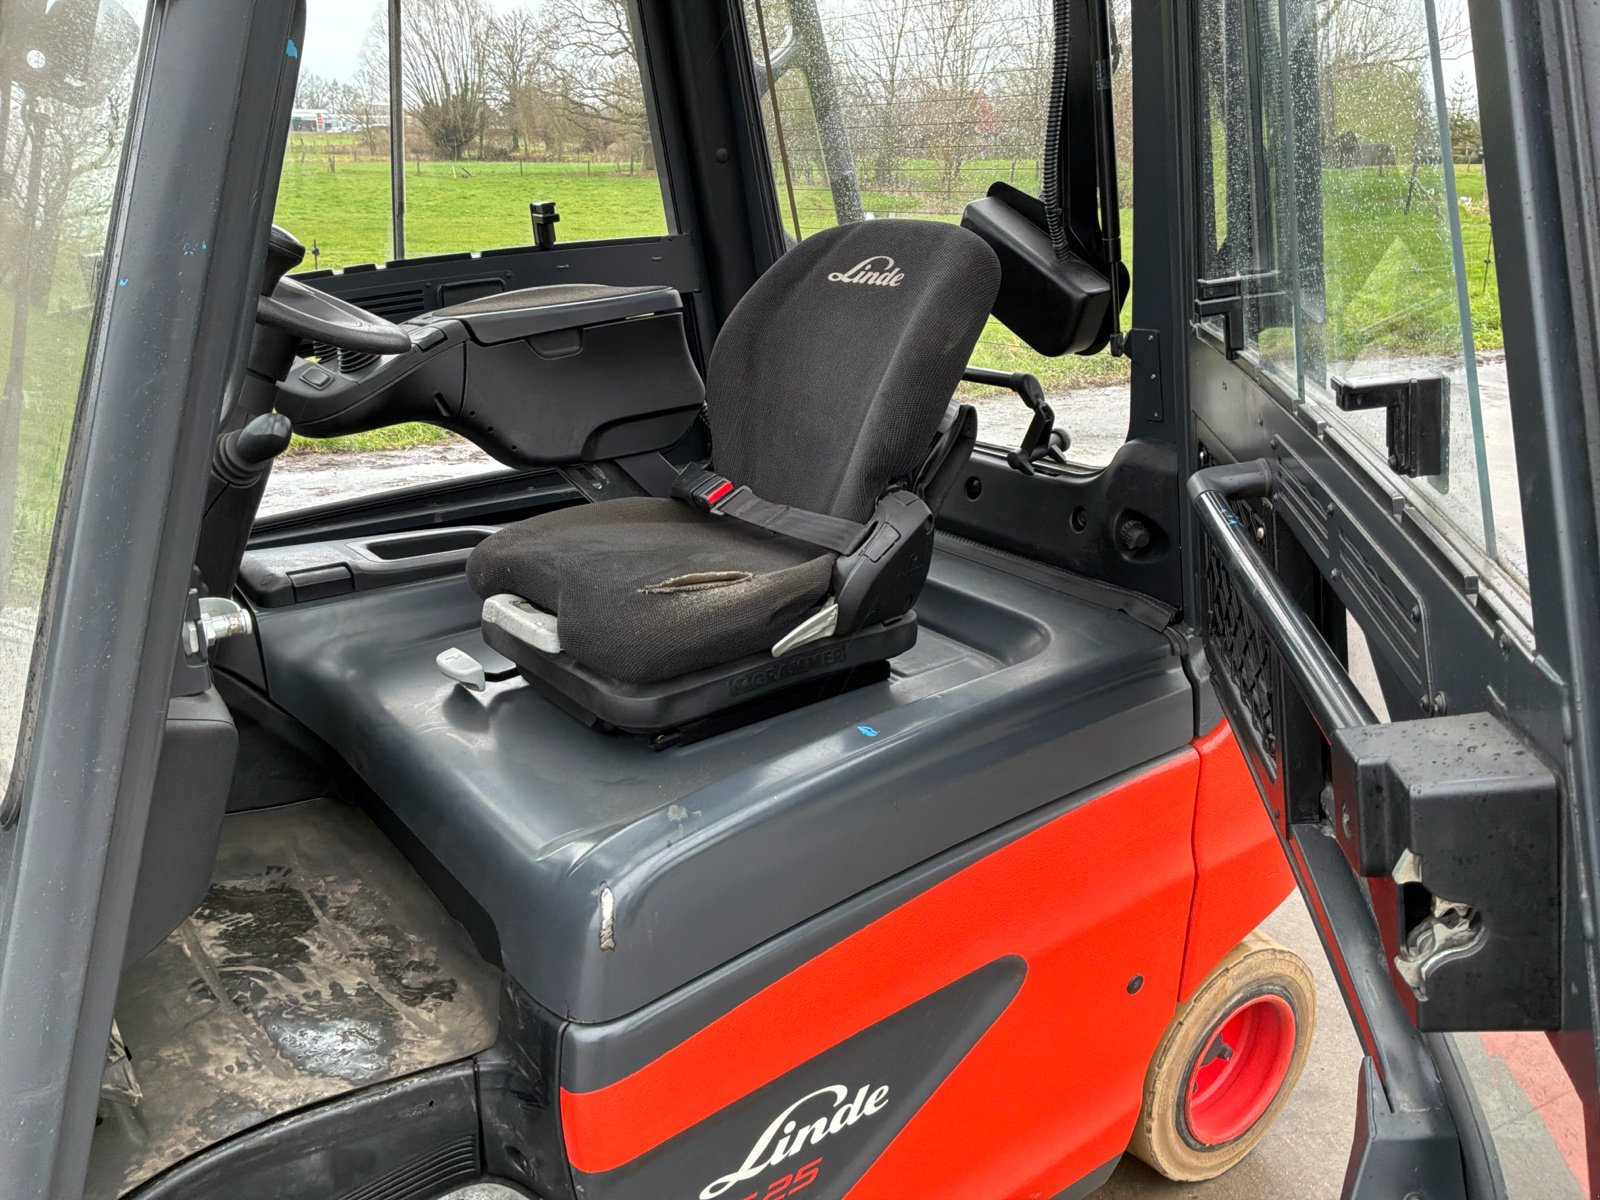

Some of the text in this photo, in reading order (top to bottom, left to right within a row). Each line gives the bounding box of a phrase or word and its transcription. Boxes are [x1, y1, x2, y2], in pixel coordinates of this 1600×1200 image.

[828, 255, 905, 287] Linde
[699, 1084, 889, 1200] Linde
[743, 1157, 823, 1200] 25
